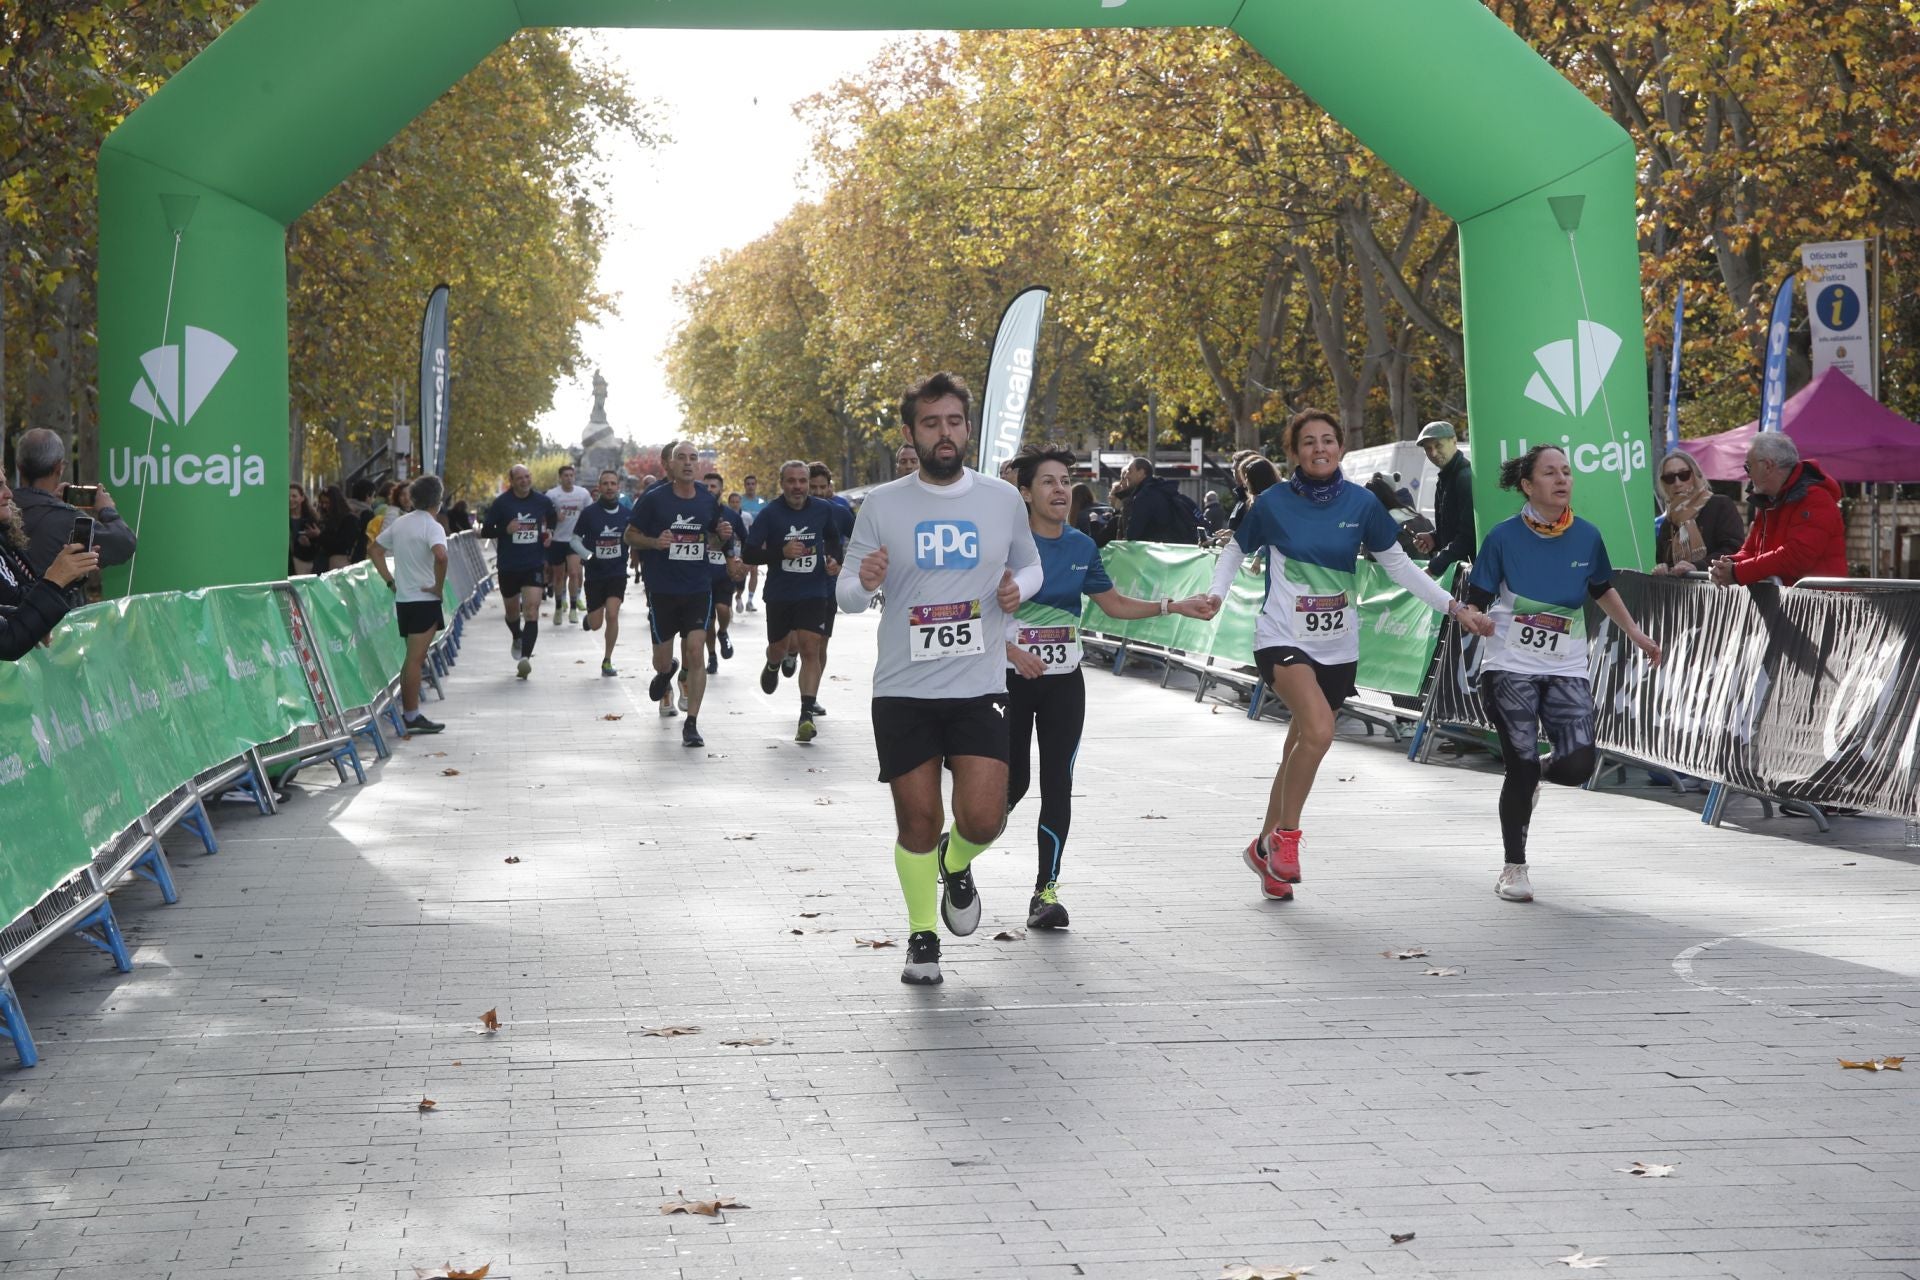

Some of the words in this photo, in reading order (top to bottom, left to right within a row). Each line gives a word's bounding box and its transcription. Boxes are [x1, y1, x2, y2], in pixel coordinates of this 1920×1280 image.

[1810, 251, 1837, 261] Oficina
[1838, 250, 1848, 259] de
[1811, 261, 1858, 273] Iormación
[1817, 273, 1846, 283] rística
[991, 347, 1033, 464] Unicaja
[1500, 431, 1646, 482] Uicaja
[110, 443, 265, 497] Unicaja
[516, 531, 535, 540] 725
[917, 524, 977, 566] PPG
[600, 546, 618, 555] 726
[675, 544, 699, 555] 713
[1306, 610, 1344, 632] 932
[920, 623, 972, 649] 765
[1519, 626, 1559, 652] 931
